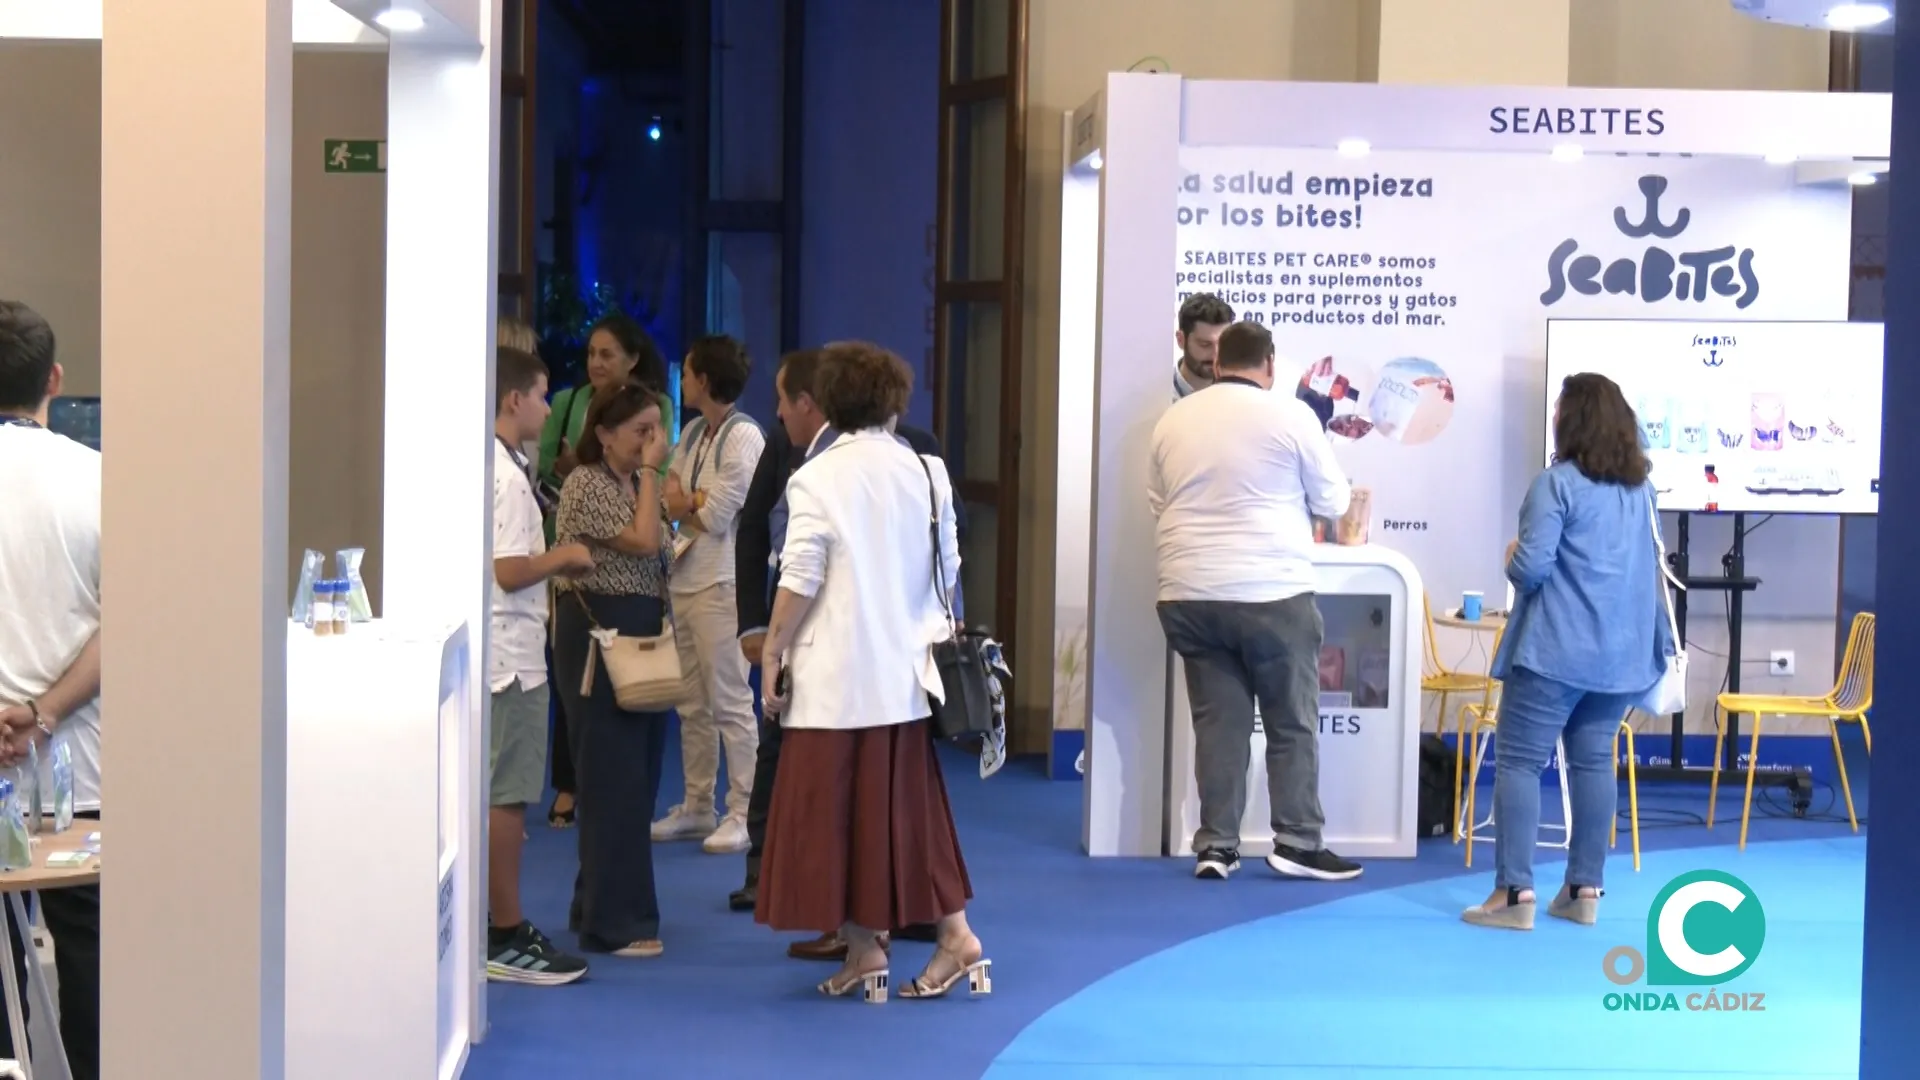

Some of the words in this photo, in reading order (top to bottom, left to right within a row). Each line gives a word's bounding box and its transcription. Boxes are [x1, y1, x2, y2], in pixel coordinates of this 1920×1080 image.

[1489, 106, 1665, 136] SEABITES
[1178, 173, 1201, 194] a
[1212, 170, 1293, 196] salud
[1305, 172, 1433, 202] empieza
[1177, 206, 1210, 226] or
[1221, 201, 1264, 227] los
[1276, 203, 1362, 229] bites!
[1184, 250, 1267, 266] SEABITES
[1273, 252, 1307, 267] PET
[1378, 256, 1436, 270] somos
[1176, 270, 1273, 287] pecialistas
[1280, 274, 1301, 285] en
[1308, 272, 1423, 289] suplementos
[1273, 292, 1316, 307] para
[1322, 294, 1382, 309] perros
[1388, 295, 1399, 312] y
[1405, 292, 1457, 311] gatos
[1243, 310, 1265, 323] en
[1271, 310, 1365, 326] productos
[1372, 310, 1399, 325] del
[1405, 312, 1445, 325] mar.
[1383, 519, 1428, 531] Perros
